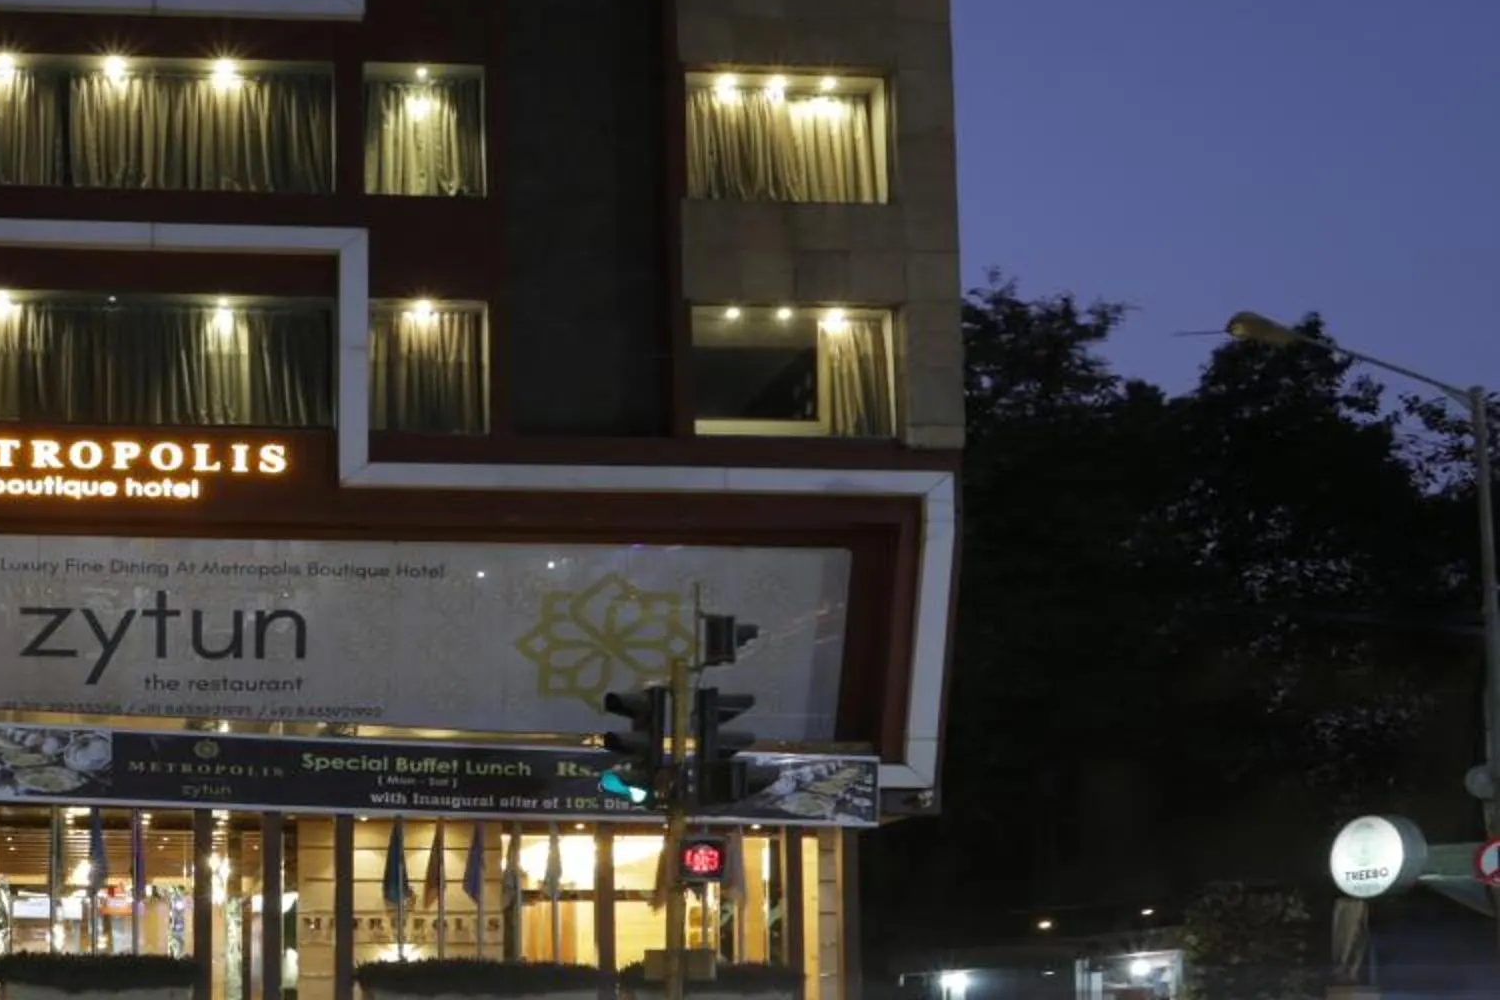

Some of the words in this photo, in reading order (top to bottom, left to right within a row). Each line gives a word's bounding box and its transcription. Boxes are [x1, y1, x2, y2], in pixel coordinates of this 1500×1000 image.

[124, 477, 200, 498] hotel
[0, 557, 59, 575] Luxury
[65, 558, 103, 573] Fine
[110, 558, 169, 577] Dining
[175, 561, 195, 574] At
[200, 561, 300, 579] Metropolis
[306, 561, 390, 579] Boutique
[395, 562, 447, 579] Hotel
[18, 589, 307, 686] zytun
[144, 673, 180, 692] the
[187, 675, 304, 693] restaurant
[301, 753, 389, 772] Special
[395, 756, 458, 774] Buffet
[465, 760, 532, 777] Lunch
[369, 791, 408, 805] with
[412, 792, 494, 809] Inaugural
[565, 796, 599, 810] 10%
